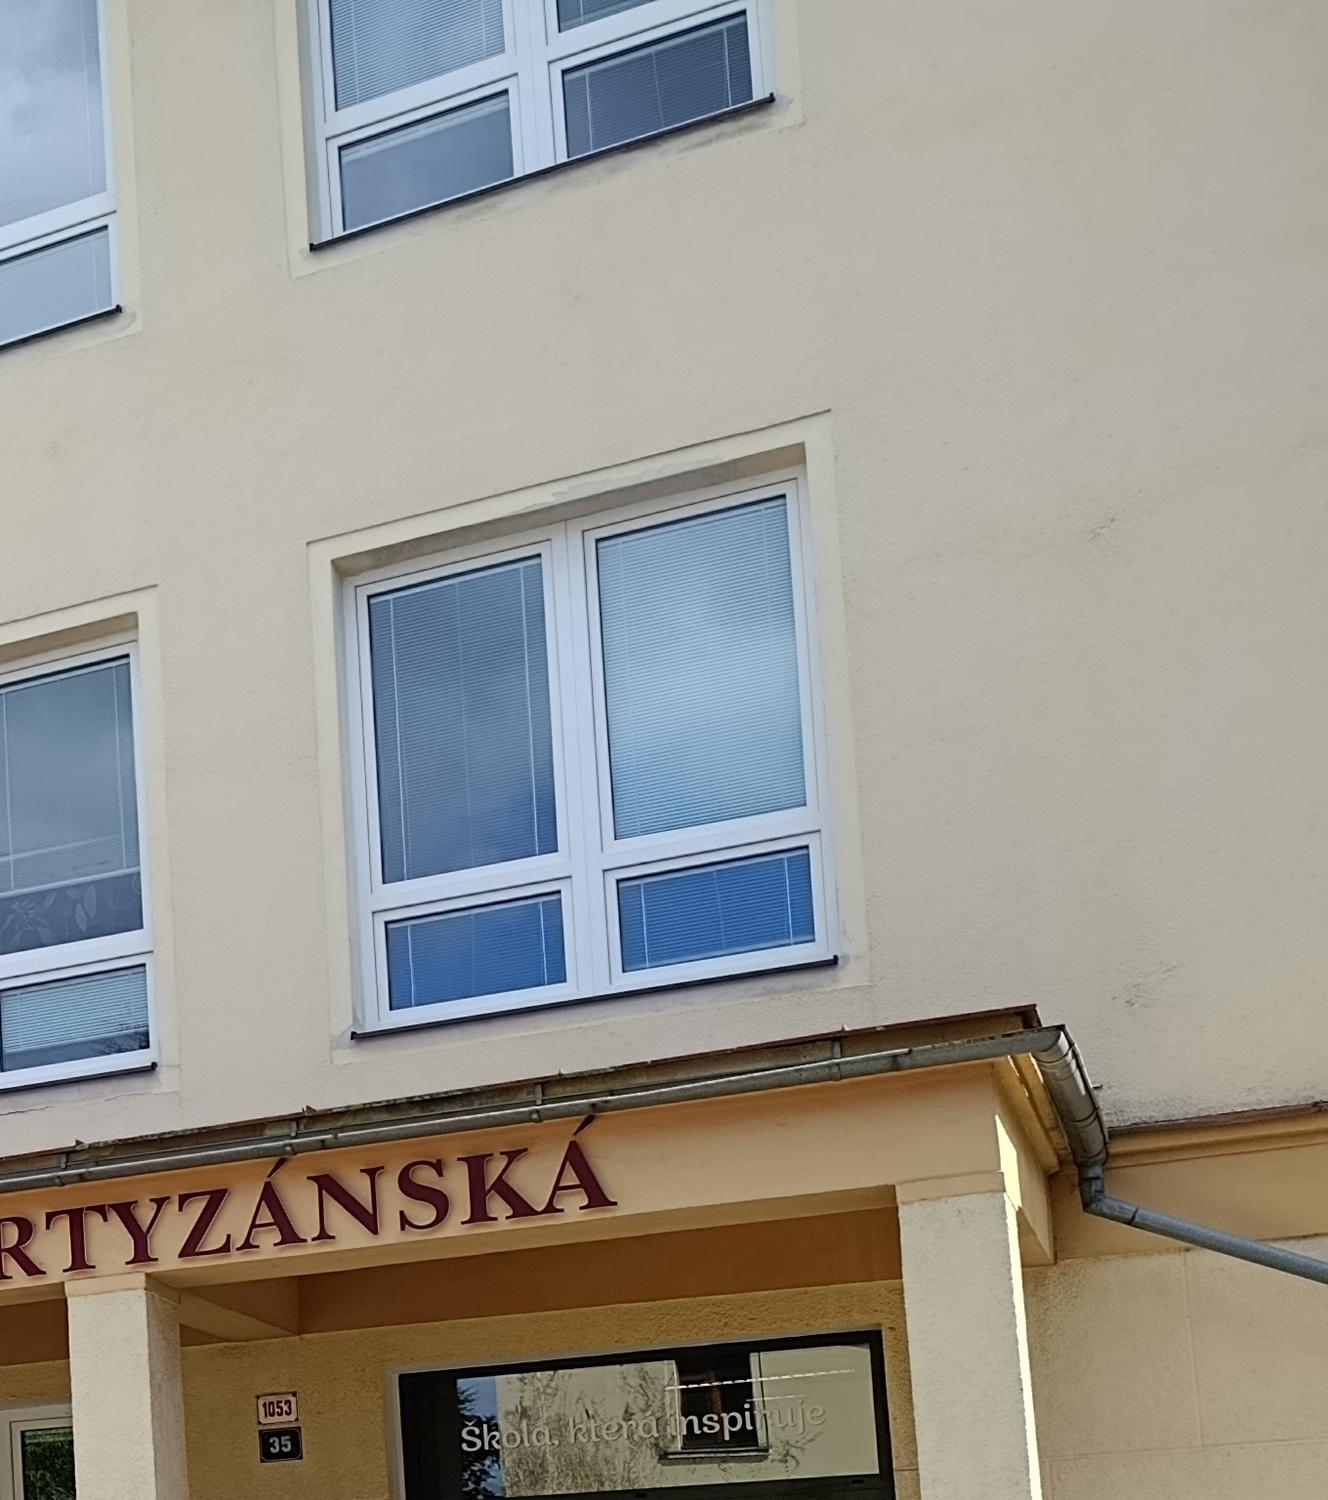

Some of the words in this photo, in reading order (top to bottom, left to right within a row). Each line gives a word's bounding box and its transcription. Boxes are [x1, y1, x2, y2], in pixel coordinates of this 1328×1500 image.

[262, 1399, 293, 1418] 1053
[569, 1411, 660, 1444] která
[666, 1400, 827, 1441] inspiruje
[269, 1435, 292, 1454] 35
